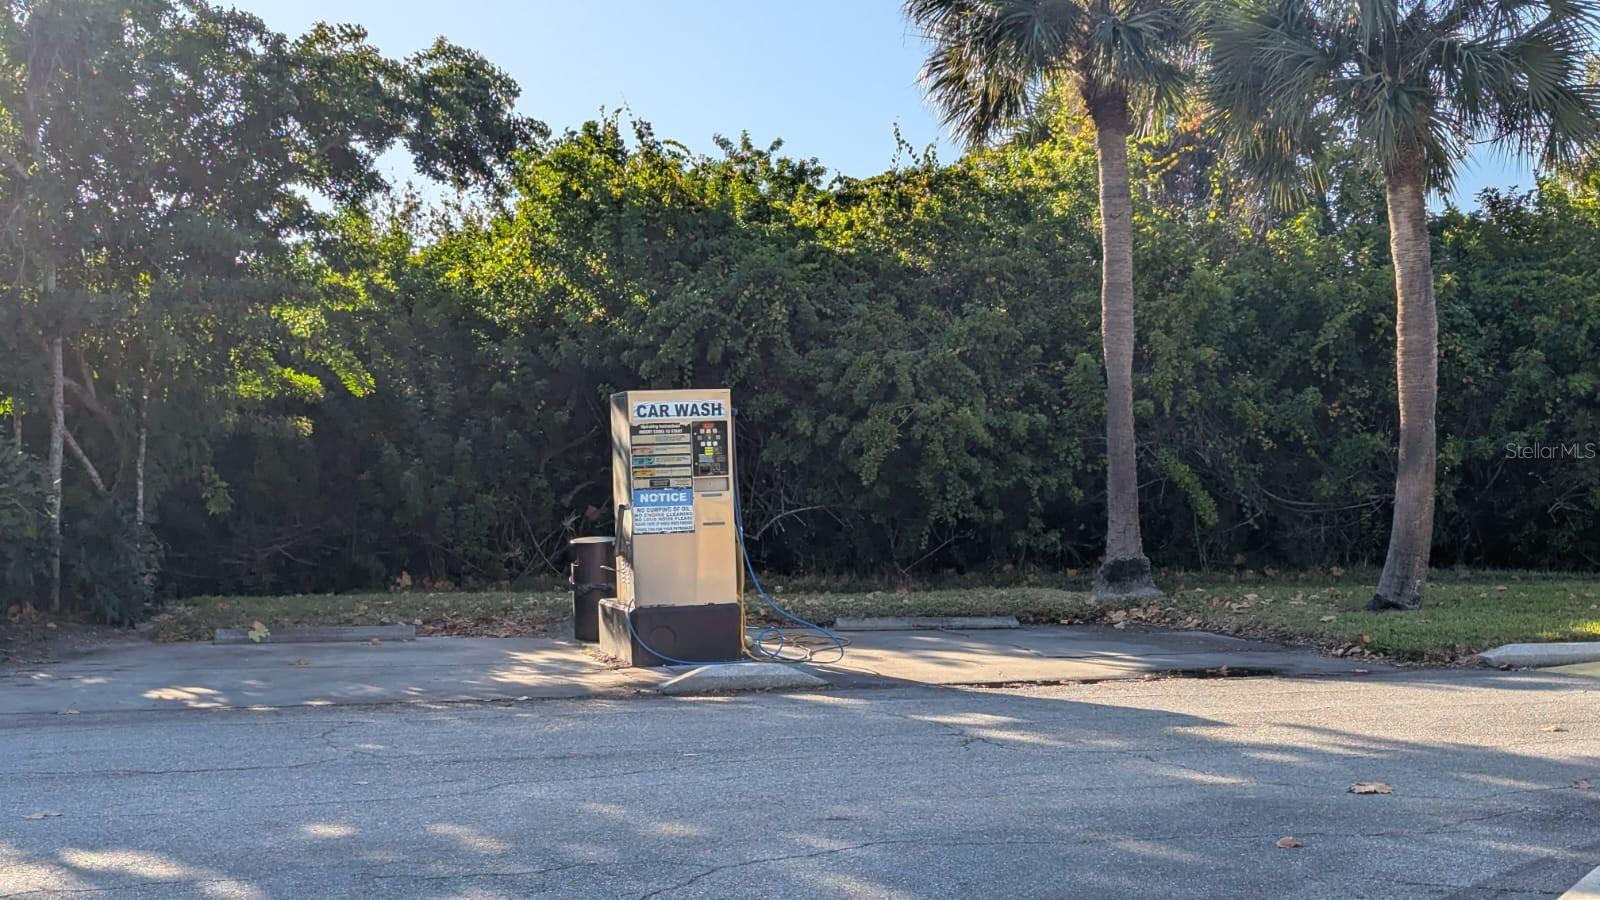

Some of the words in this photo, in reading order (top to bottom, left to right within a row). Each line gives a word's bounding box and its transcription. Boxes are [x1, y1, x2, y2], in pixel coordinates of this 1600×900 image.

[636, 404, 670, 418] CAR
[674, 402, 722, 417] WASH
[639, 492, 688, 503] NOTICE
